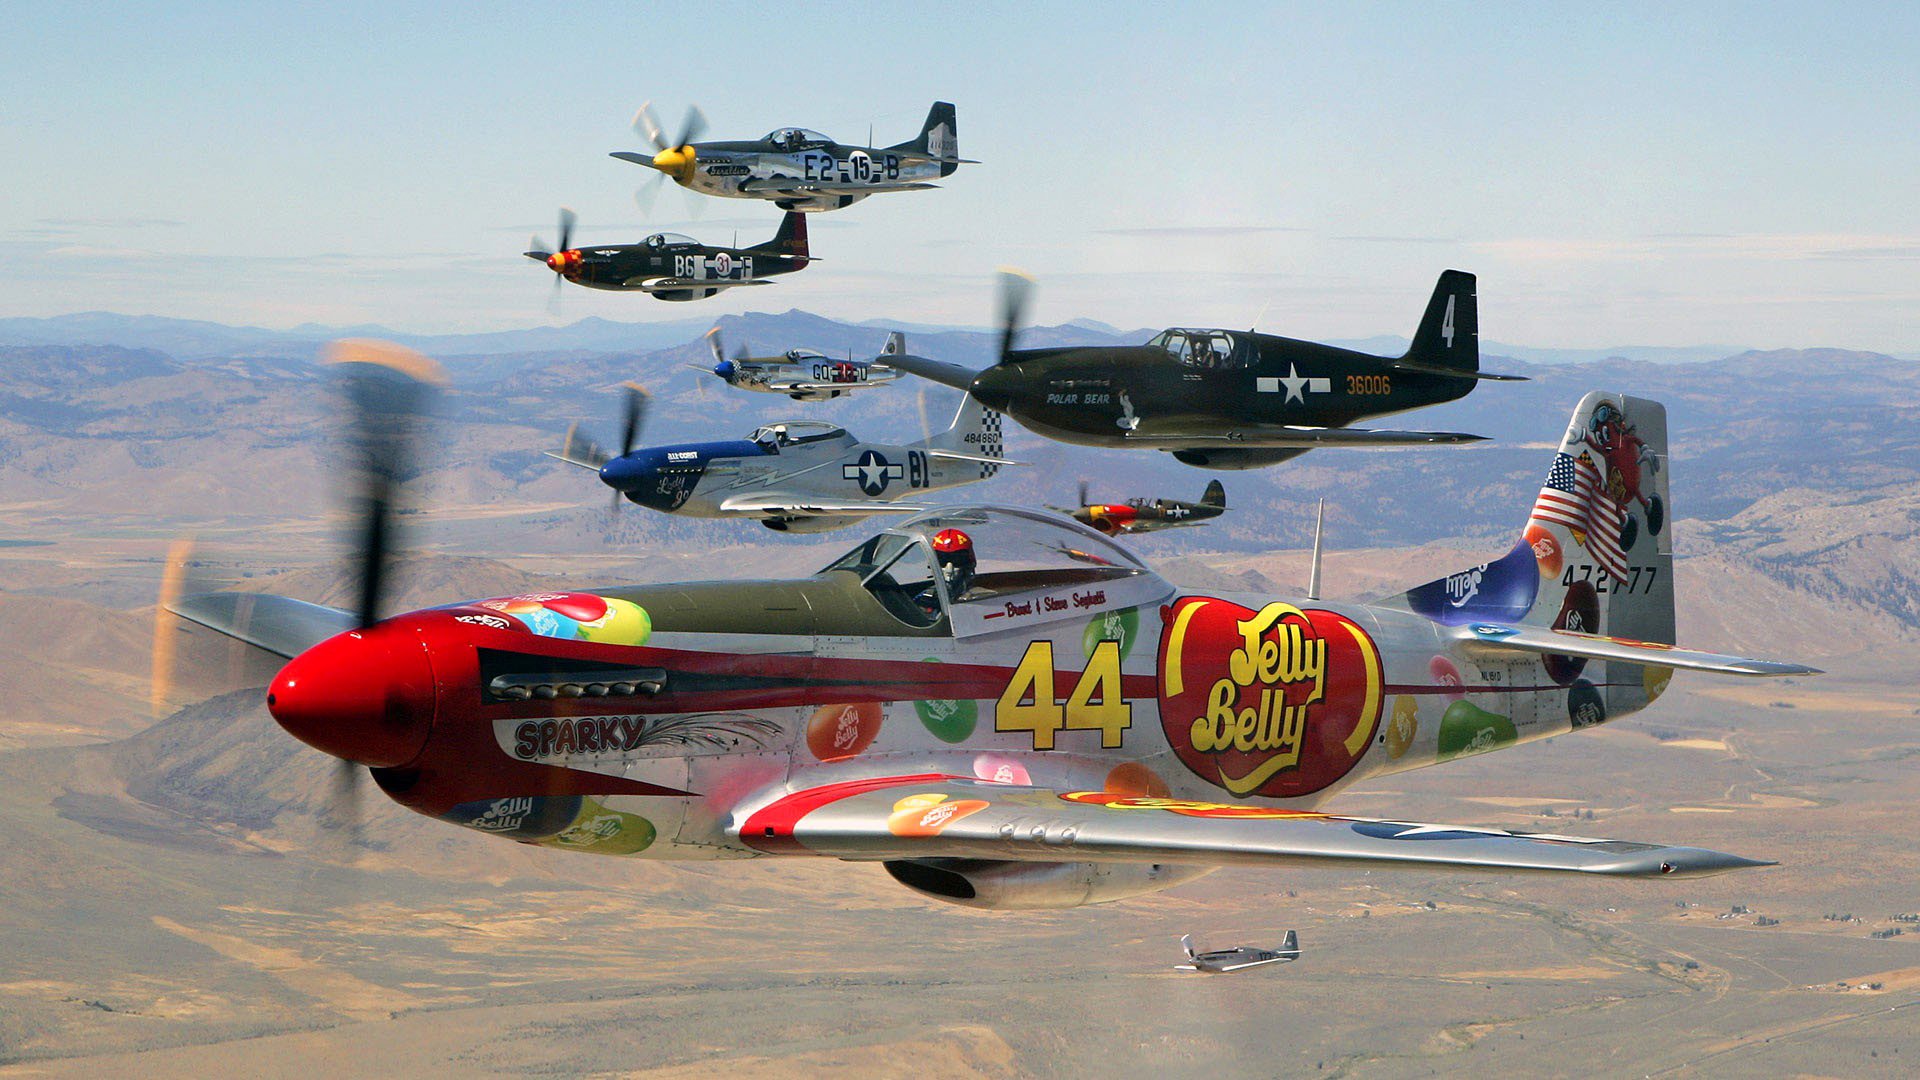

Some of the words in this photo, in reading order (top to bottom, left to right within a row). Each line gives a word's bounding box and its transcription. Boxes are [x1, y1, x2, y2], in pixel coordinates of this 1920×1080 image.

[805, 154, 833, 181] E2
[851, 156, 870, 180] 15
[886, 154, 899, 180] B
[717, 256, 730, 273] 31
[1441, 294, 1456, 348] 4
[813, 364, 830, 381] GQ
[1346, 375, 1391, 395] 36006
[1047, 393, 1078, 404] POLAR
[1084, 393, 1110, 404] BEAR
[964, 433, 998, 444] 484860
[908, 450, 929, 488] 81
[656, 475, 686, 495] Lady
[1005, 601, 1033, 618] Brent
[1044, 596, 1069, 611] Steve
[1230, 601, 1327, 706] Jelly
[995, 640, 1132, 751] 44
[838, 705, 859, 731] Jelly
[515, 716, 646, 759] SPARKY
[833, 725, 858, 750] Belly
[1190, 678, 1307, 795] Belly
[483, 797, 533, 819] Jelly
